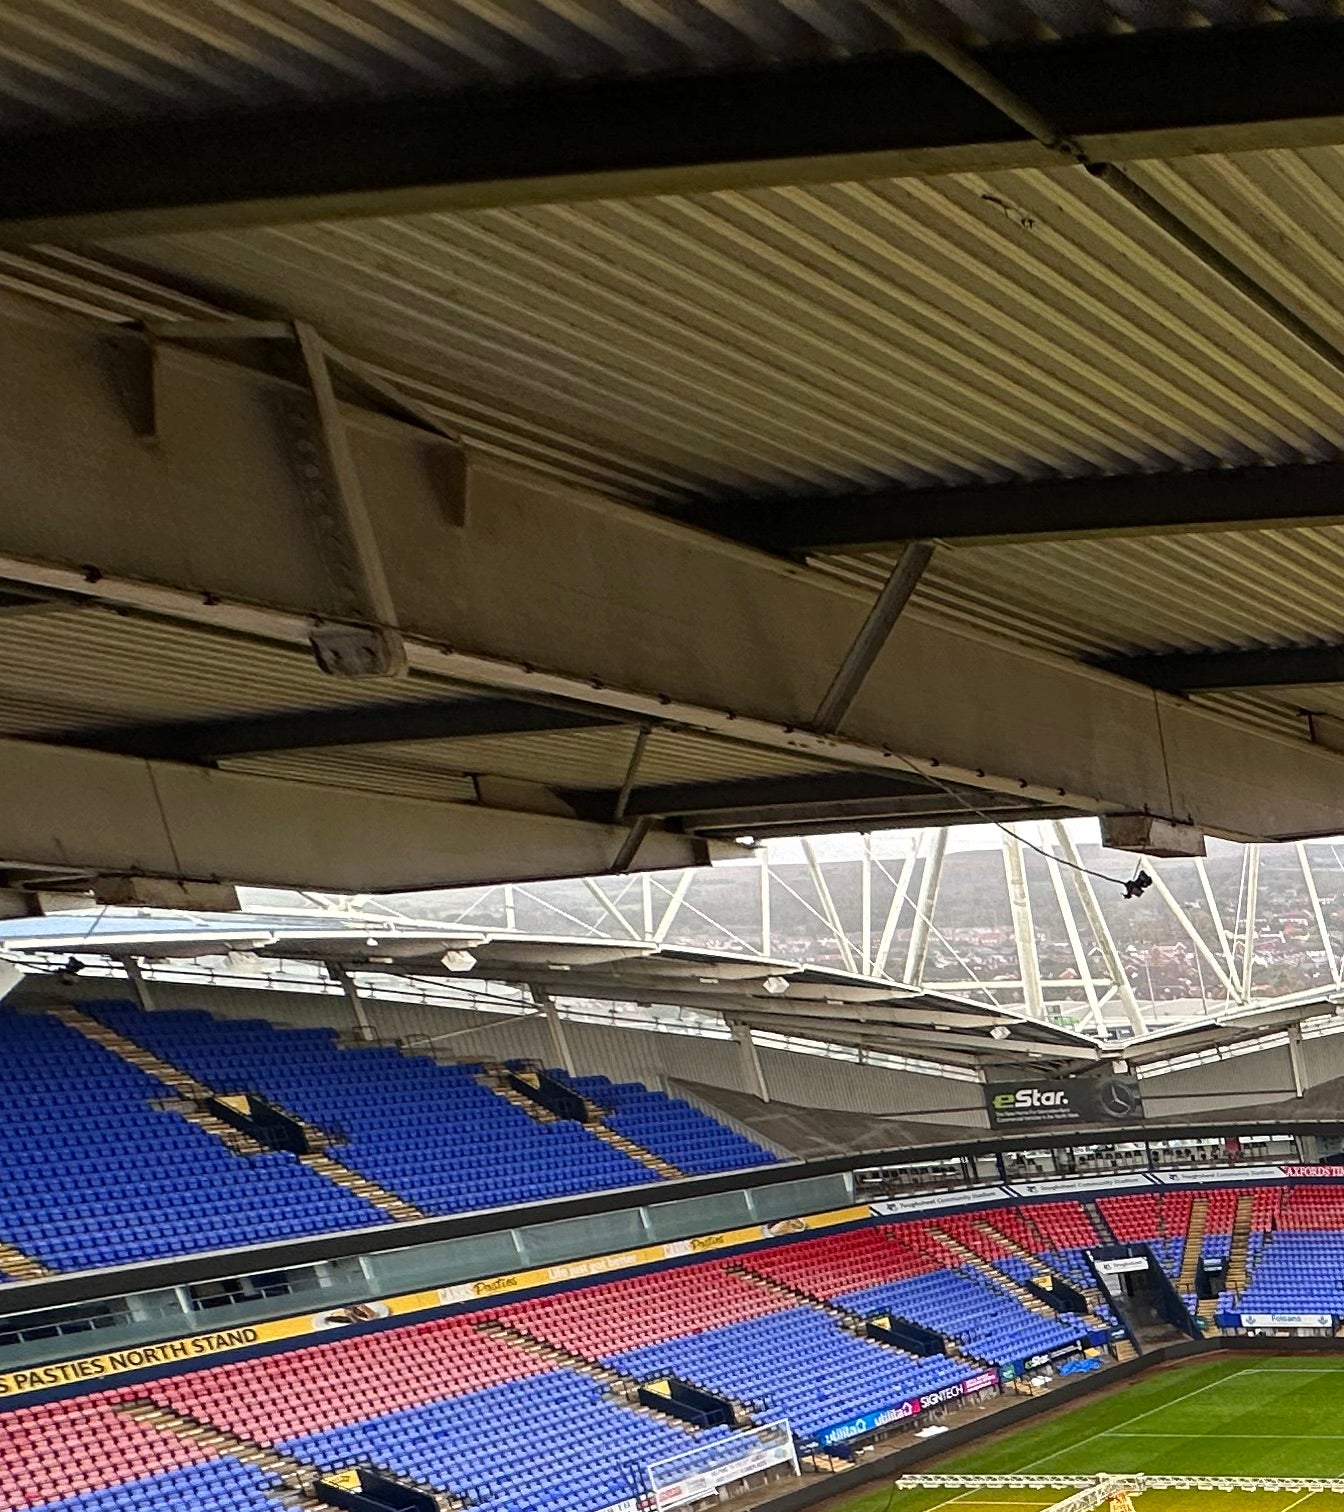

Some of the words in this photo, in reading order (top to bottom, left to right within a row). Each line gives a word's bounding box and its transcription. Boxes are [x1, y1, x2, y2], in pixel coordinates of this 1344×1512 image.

[474, 1277, 518, 1295] Pasties
[13, 1356, 105, 1391] PASTIES
[109, 1341, 188, 1372] NORTH
[191, 1328, 258, 1354] STAND
[920, 1385, 964, 1408] SIGNTECH
